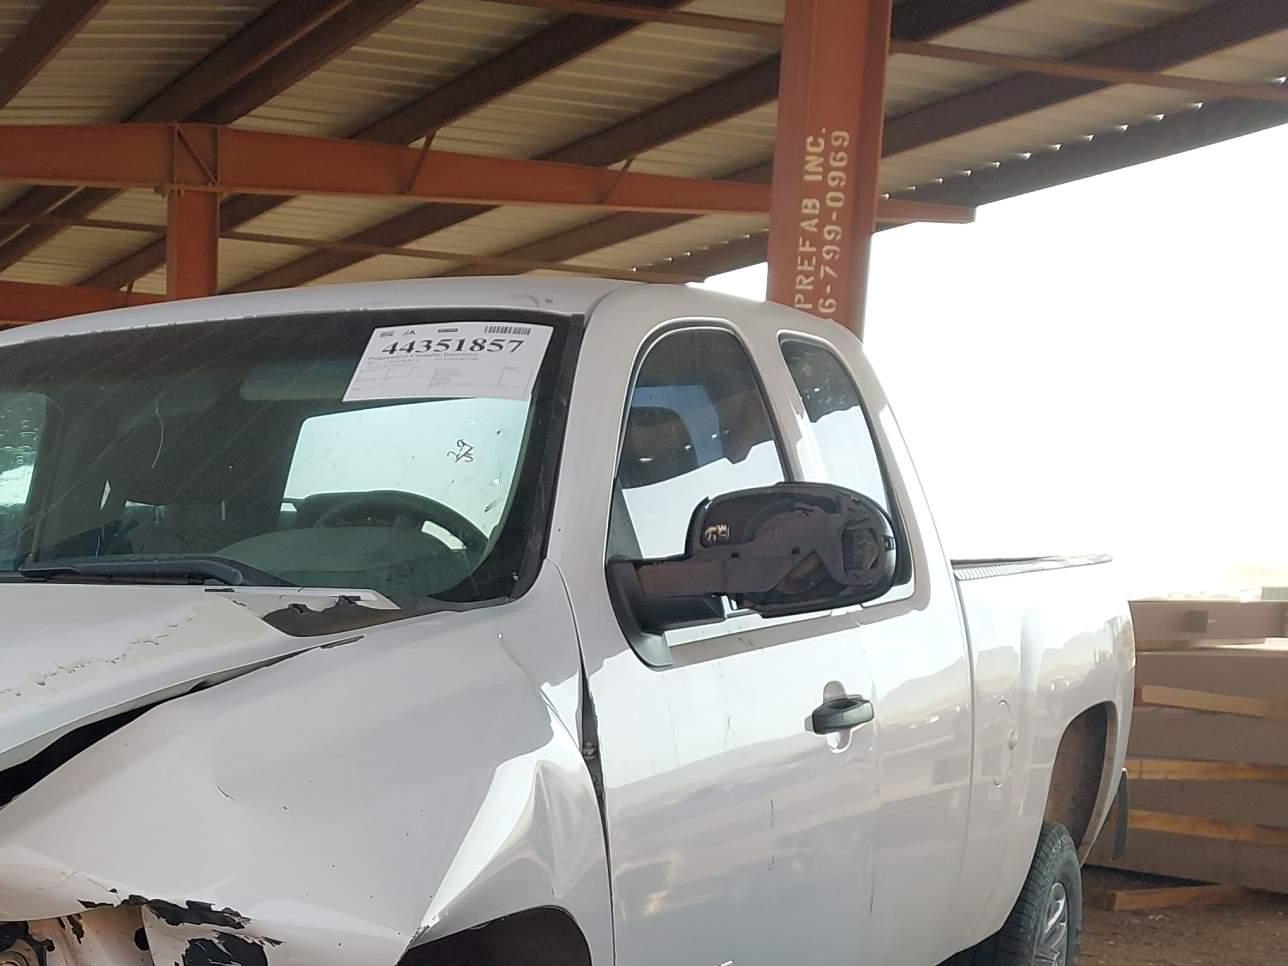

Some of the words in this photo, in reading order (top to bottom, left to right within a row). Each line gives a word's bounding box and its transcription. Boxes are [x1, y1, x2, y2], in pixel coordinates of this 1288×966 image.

[804, 127, 827, 181] INC.
[794, 198, 821, 309] PREFAB
[381, 337, 525, 355] 44351857
